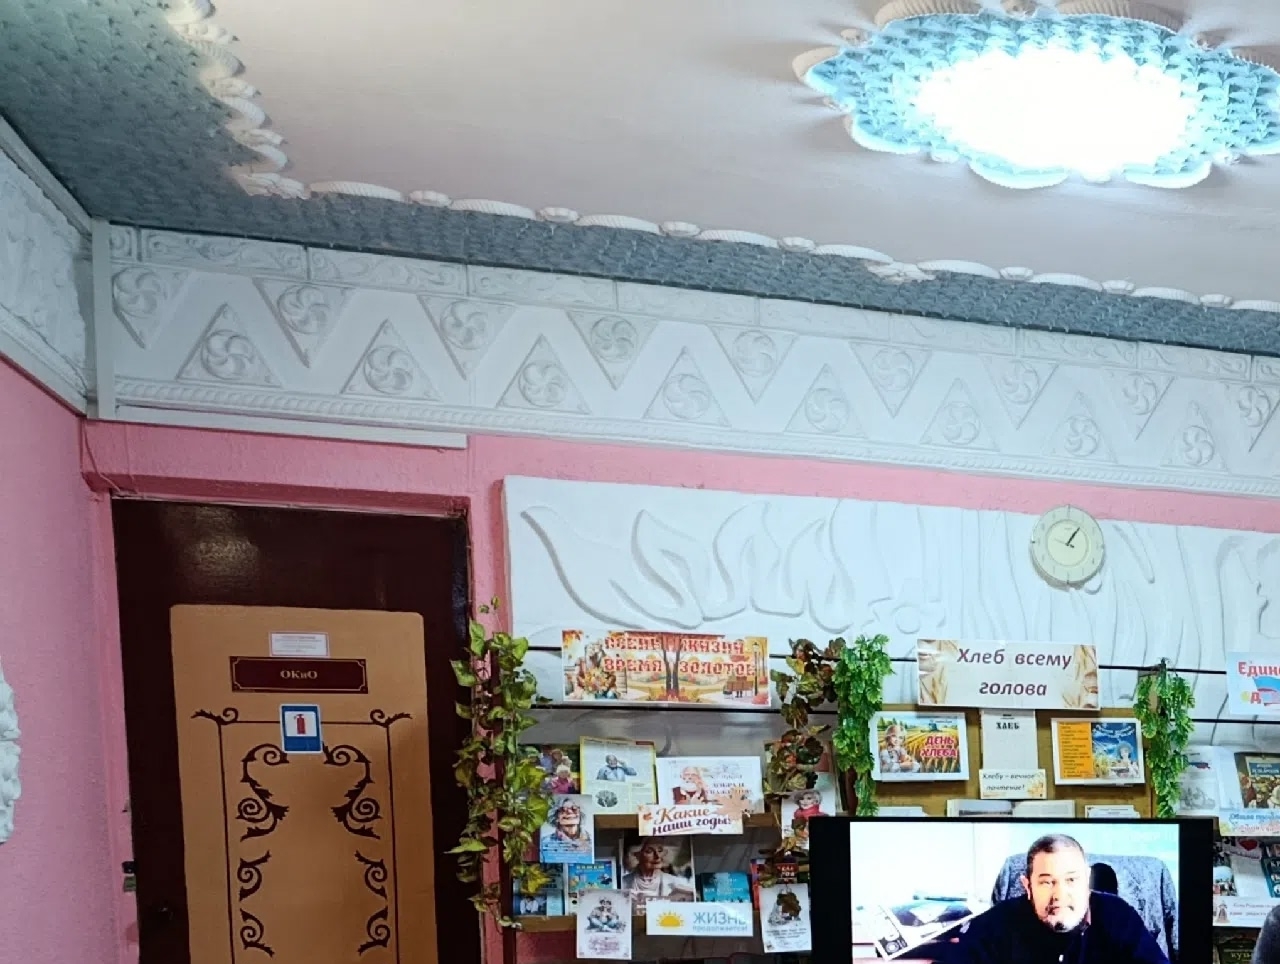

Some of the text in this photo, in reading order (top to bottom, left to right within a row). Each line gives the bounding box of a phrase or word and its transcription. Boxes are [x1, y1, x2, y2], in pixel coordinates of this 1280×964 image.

[604, 658, 662, 672] ВРЕМЯ
[957, 648, 1072, 670] Хлеб всему
[979, 682, 1047, 696] голова
[996, 722, 1020, 730] ХЛЕБ
[925, 736, 954, 745] ДЕНЬ
[921, 749, 956, 757] ХЛЕБА
[655, 807, 710, 825] Какие
[652, 819, 692, 835] наши
